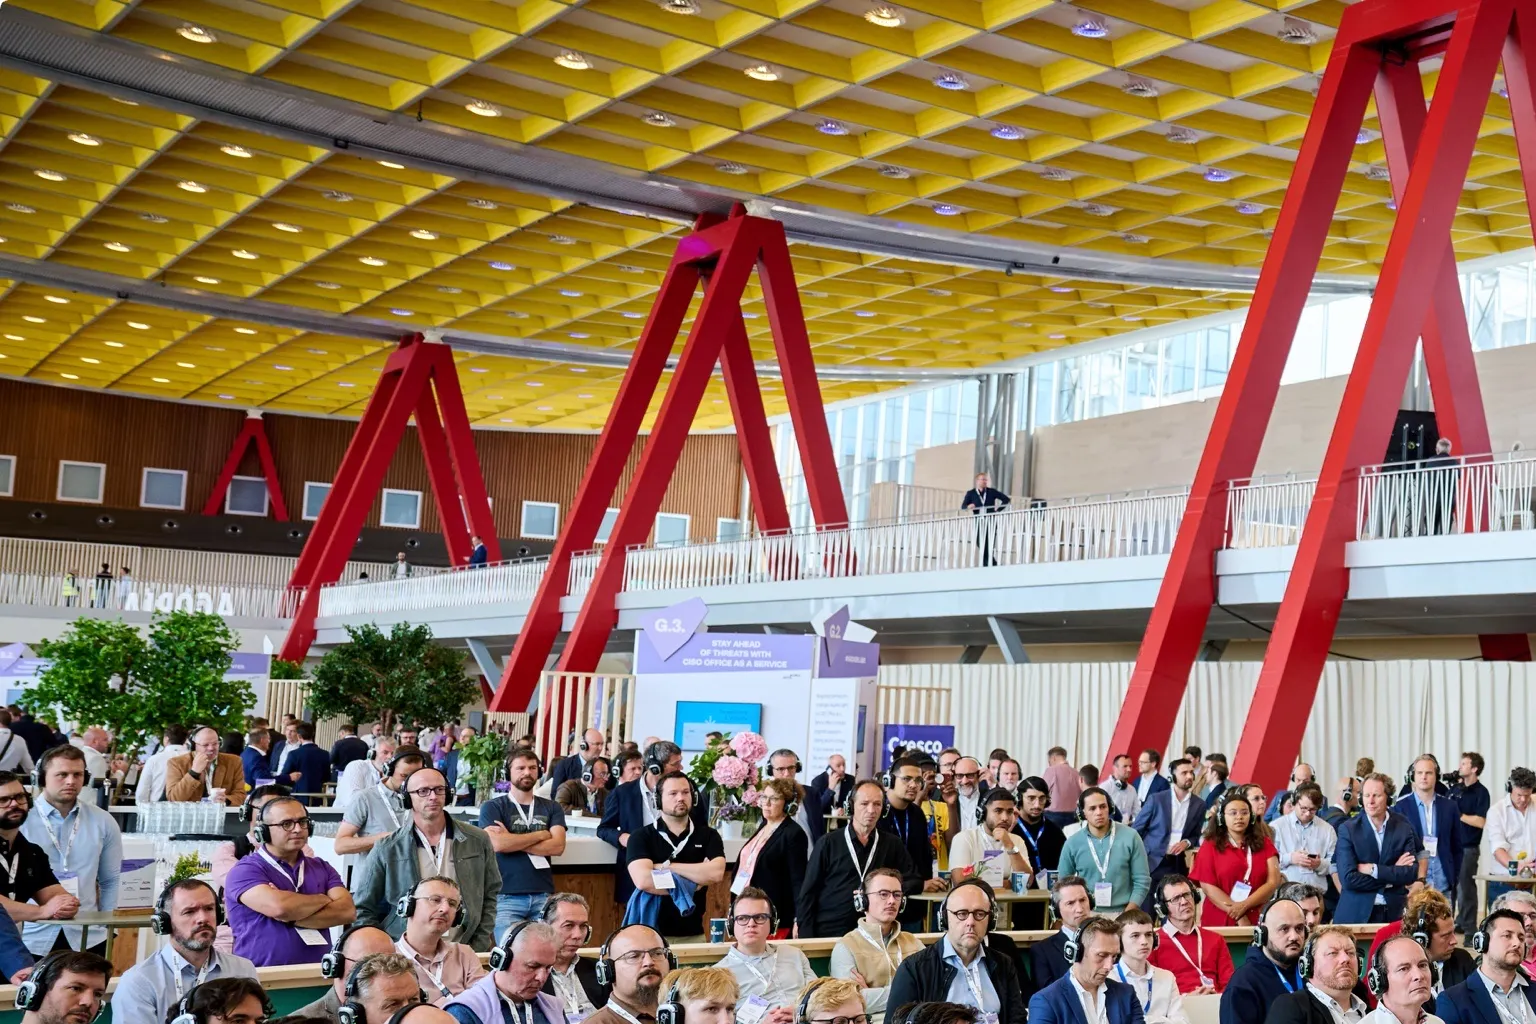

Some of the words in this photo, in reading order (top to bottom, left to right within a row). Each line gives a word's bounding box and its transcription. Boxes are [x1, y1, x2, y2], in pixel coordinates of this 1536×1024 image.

[655, 618, 686, 633] G.3.
[712, 640, 732, 648] STAY
[733, 640, 760, 648] AHEAD
[751, 650, 771, 658] WITH
[704, 659, 732, 667] OFFICE
